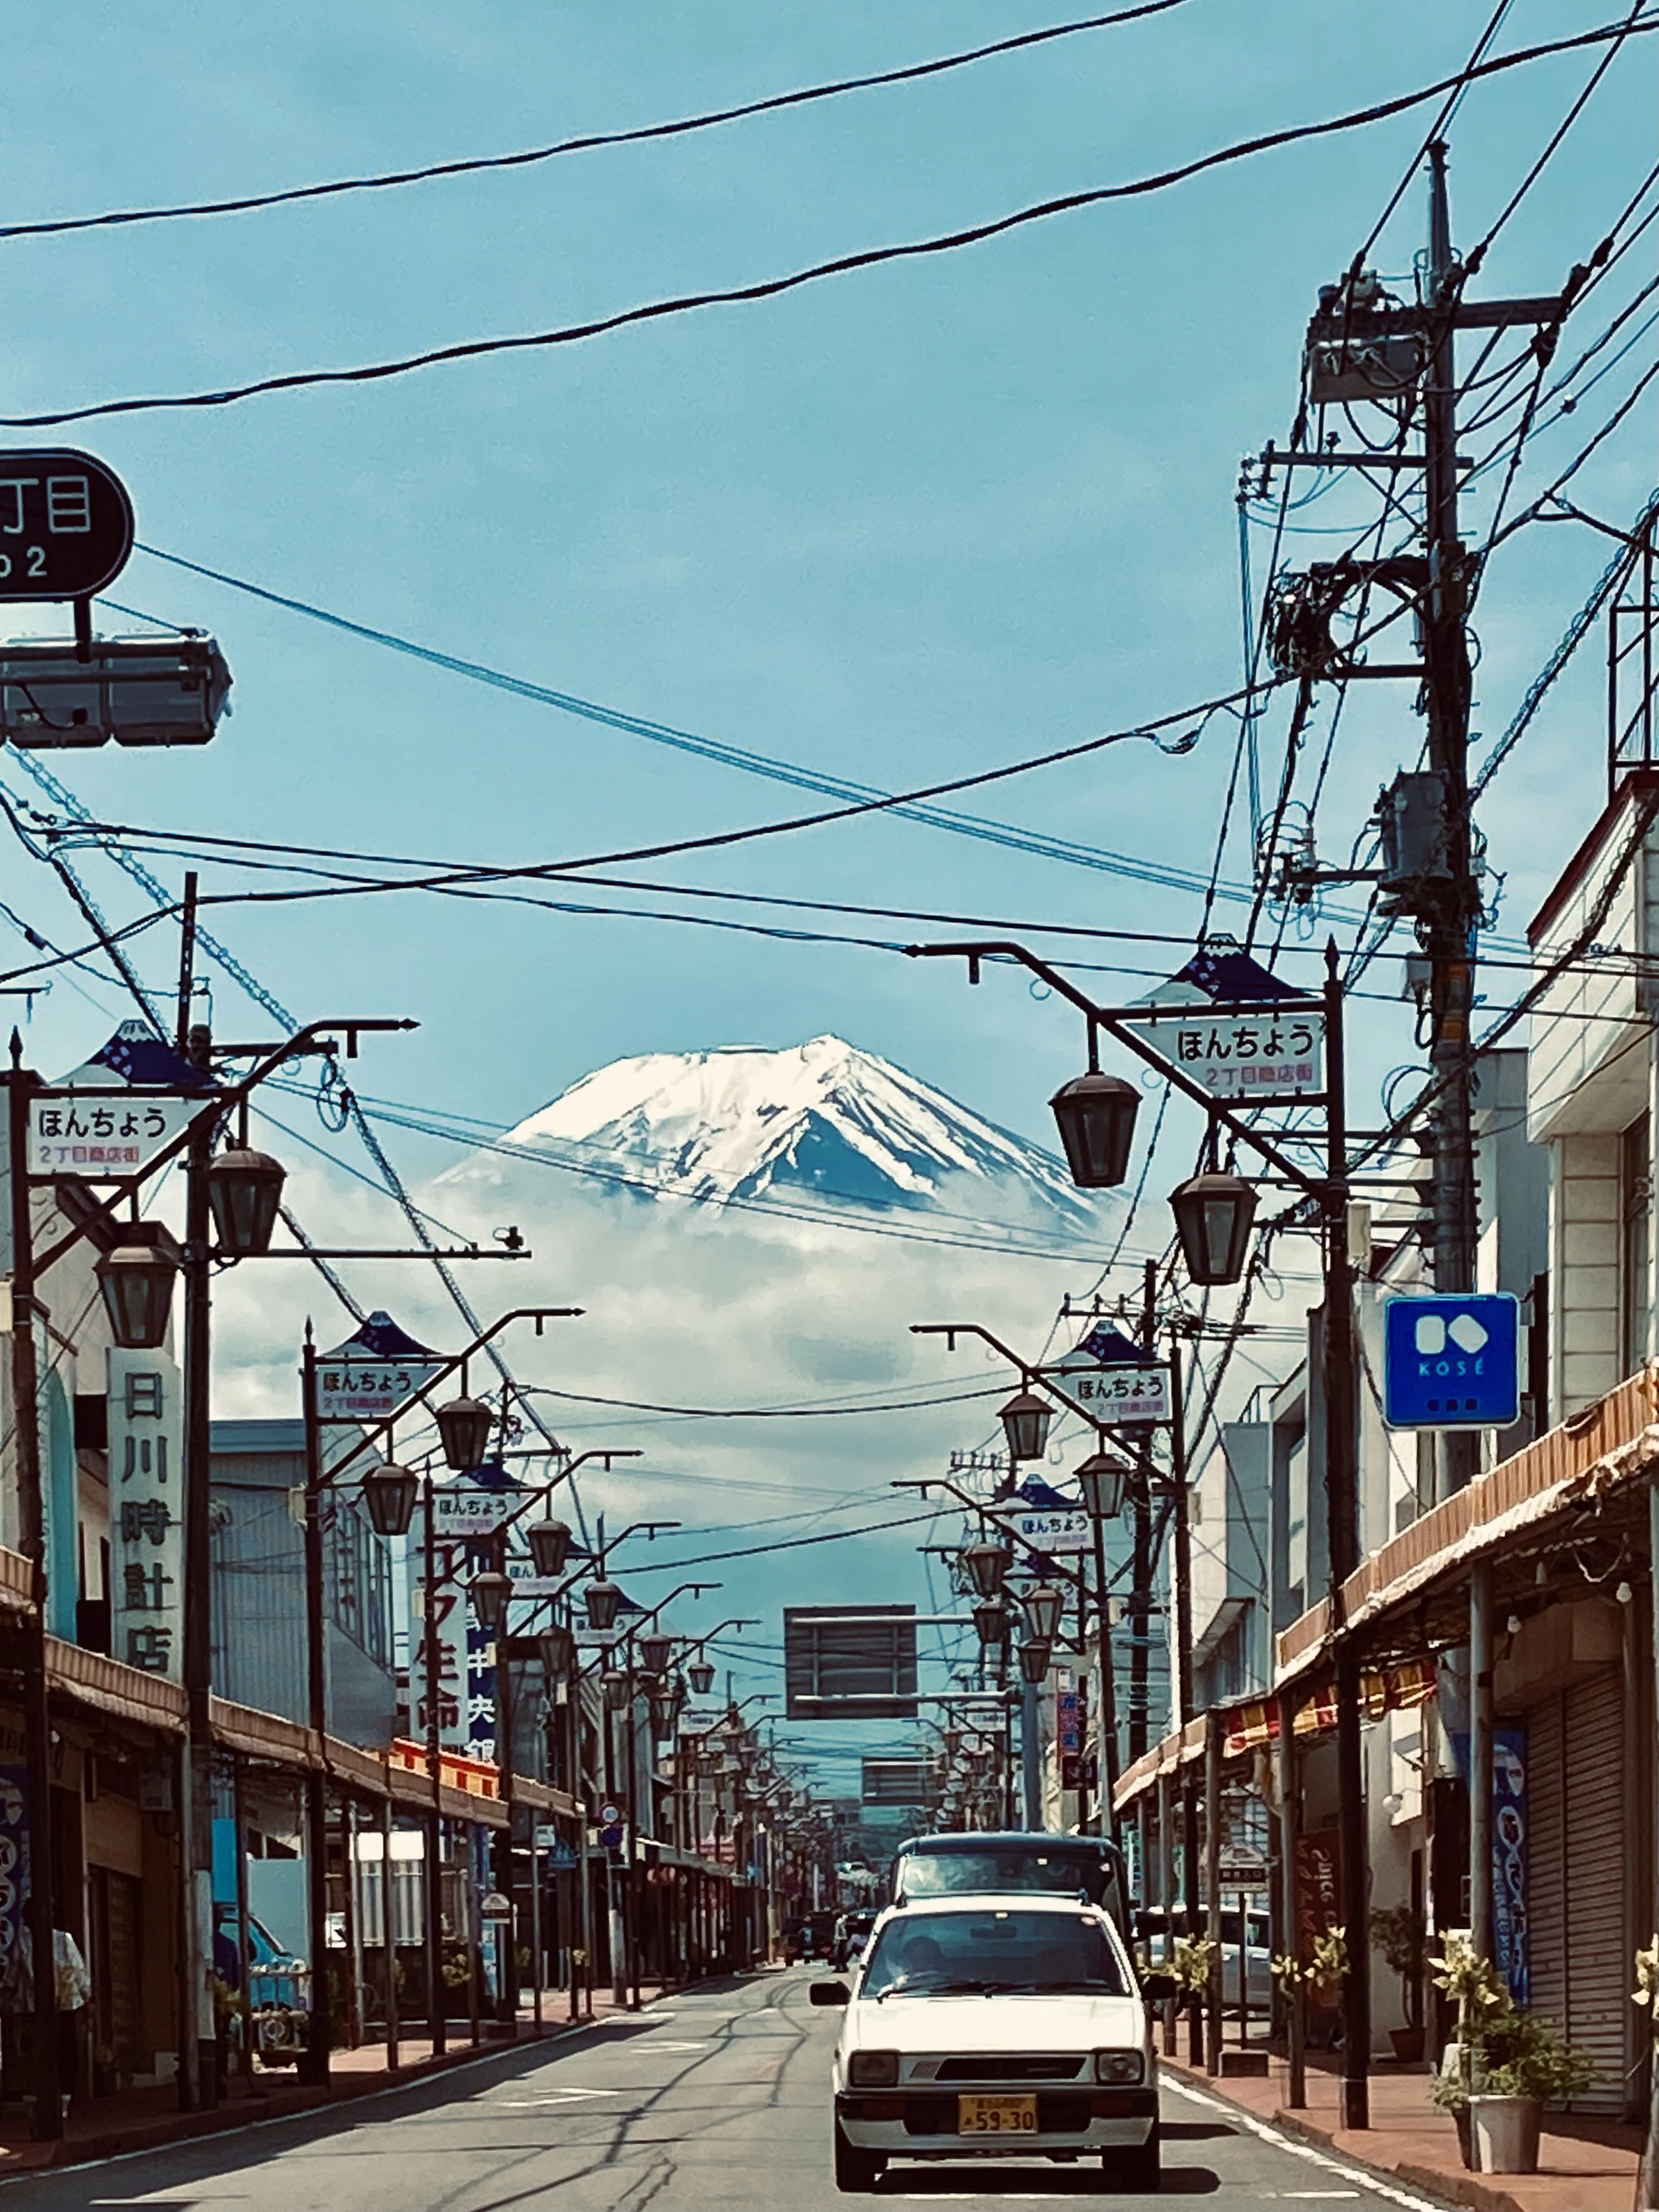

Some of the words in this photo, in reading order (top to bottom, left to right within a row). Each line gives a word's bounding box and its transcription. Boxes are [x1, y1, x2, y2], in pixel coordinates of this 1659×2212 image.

[26, 546, 48, 577] 2
[1177, 1023, 1314, 1060] ほんちょう
[39, 1107, 166, 1138] ほんちょう
[323, 1371, 411, 1393] ほんちょう
[1419, 1357, 1484, 1377] KOSÉ
[1078, 1376, 1163, 1400] ほんちょう
[121, 1372, 174, 1673] 日川時計店
